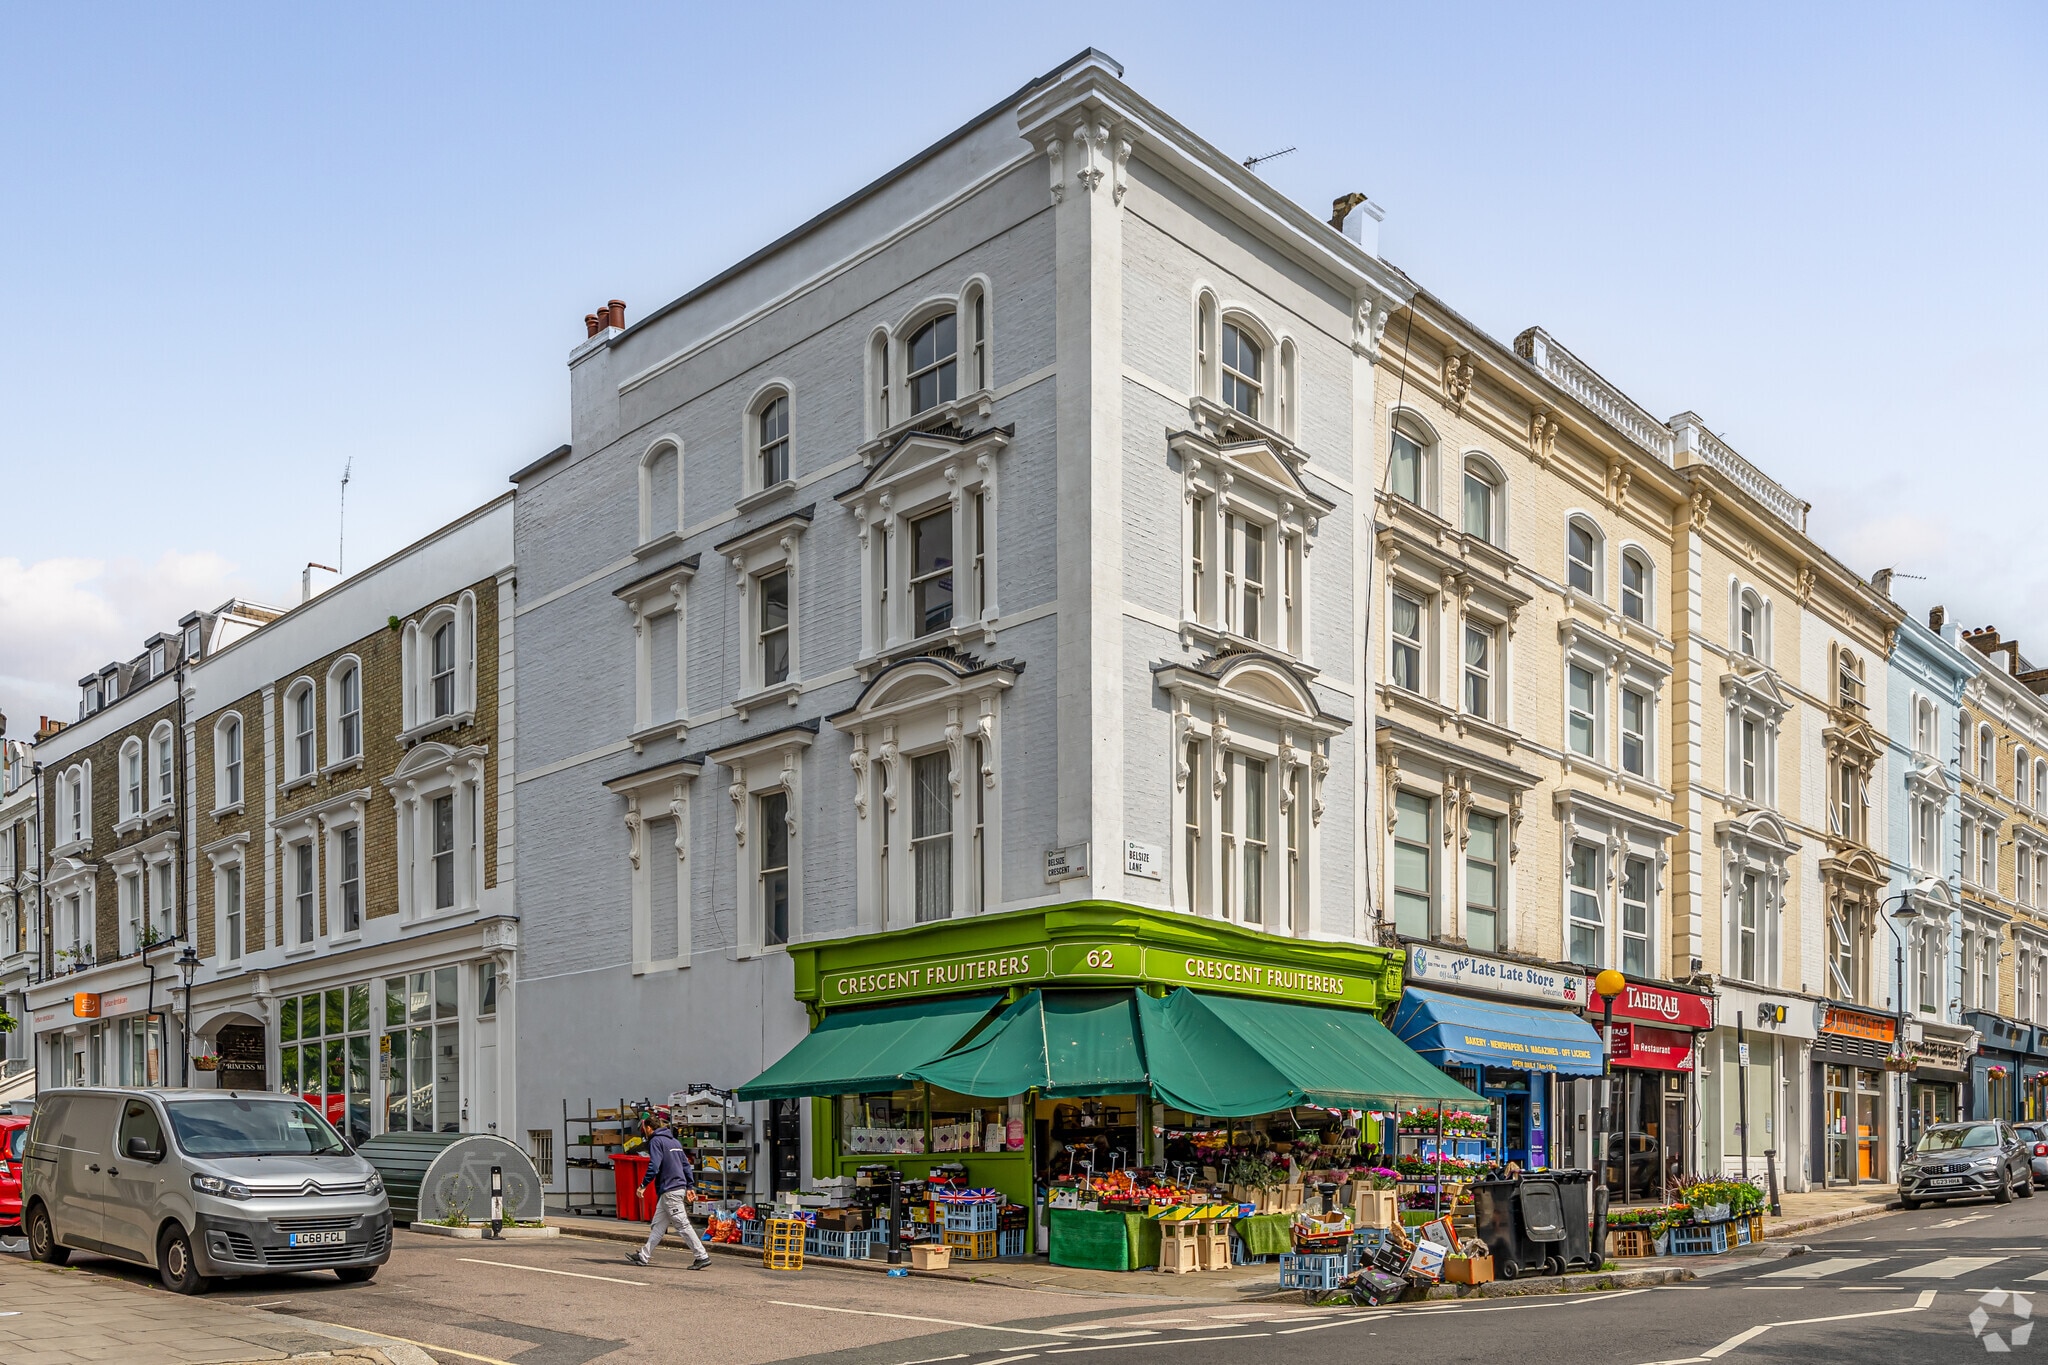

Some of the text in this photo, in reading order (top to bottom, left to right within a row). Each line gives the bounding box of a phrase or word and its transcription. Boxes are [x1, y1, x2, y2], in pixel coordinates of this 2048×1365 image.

[1048, 856, 1065, 867] BELSIZE
[1129, 850, 1150, 862] BELSIZE
[1048, 866, 1070, 877] CRESCENT
[1128, 862, 1142, 872] LANE
[1087, 950, 1114, 968] 62
[838, 955, 1030, 995] CRESCENT FRUITERERS
[1185, 958, 1344, 995] CRESCENT FRUITERERS
[1451, 957, 1554, 988] The Late Late Store
[1542, 987, 1563, 997] Groceries
[1626, 986, 1680, 1020] TAHERAH
[1464, 1036, 1486, 1046] BAKERY
[1490, 1040, 1524, 1052] NEWSPAPERS
[1525, 1044, 1530, 1052] &
[1530, 1045, 1558, 1056] MAGAZINES
[1562, 1049, 1571, 1057] OFF
[1572, 1050, 1592, 1059] LICENCE
[1640, 1042, 1670, 1054] Restaurant
[1512, 1060, 1524, 1068] OPEN
[464, 1098, 469, 1107] 2
[296, 1232, 343, 1244] LC68 FCL
